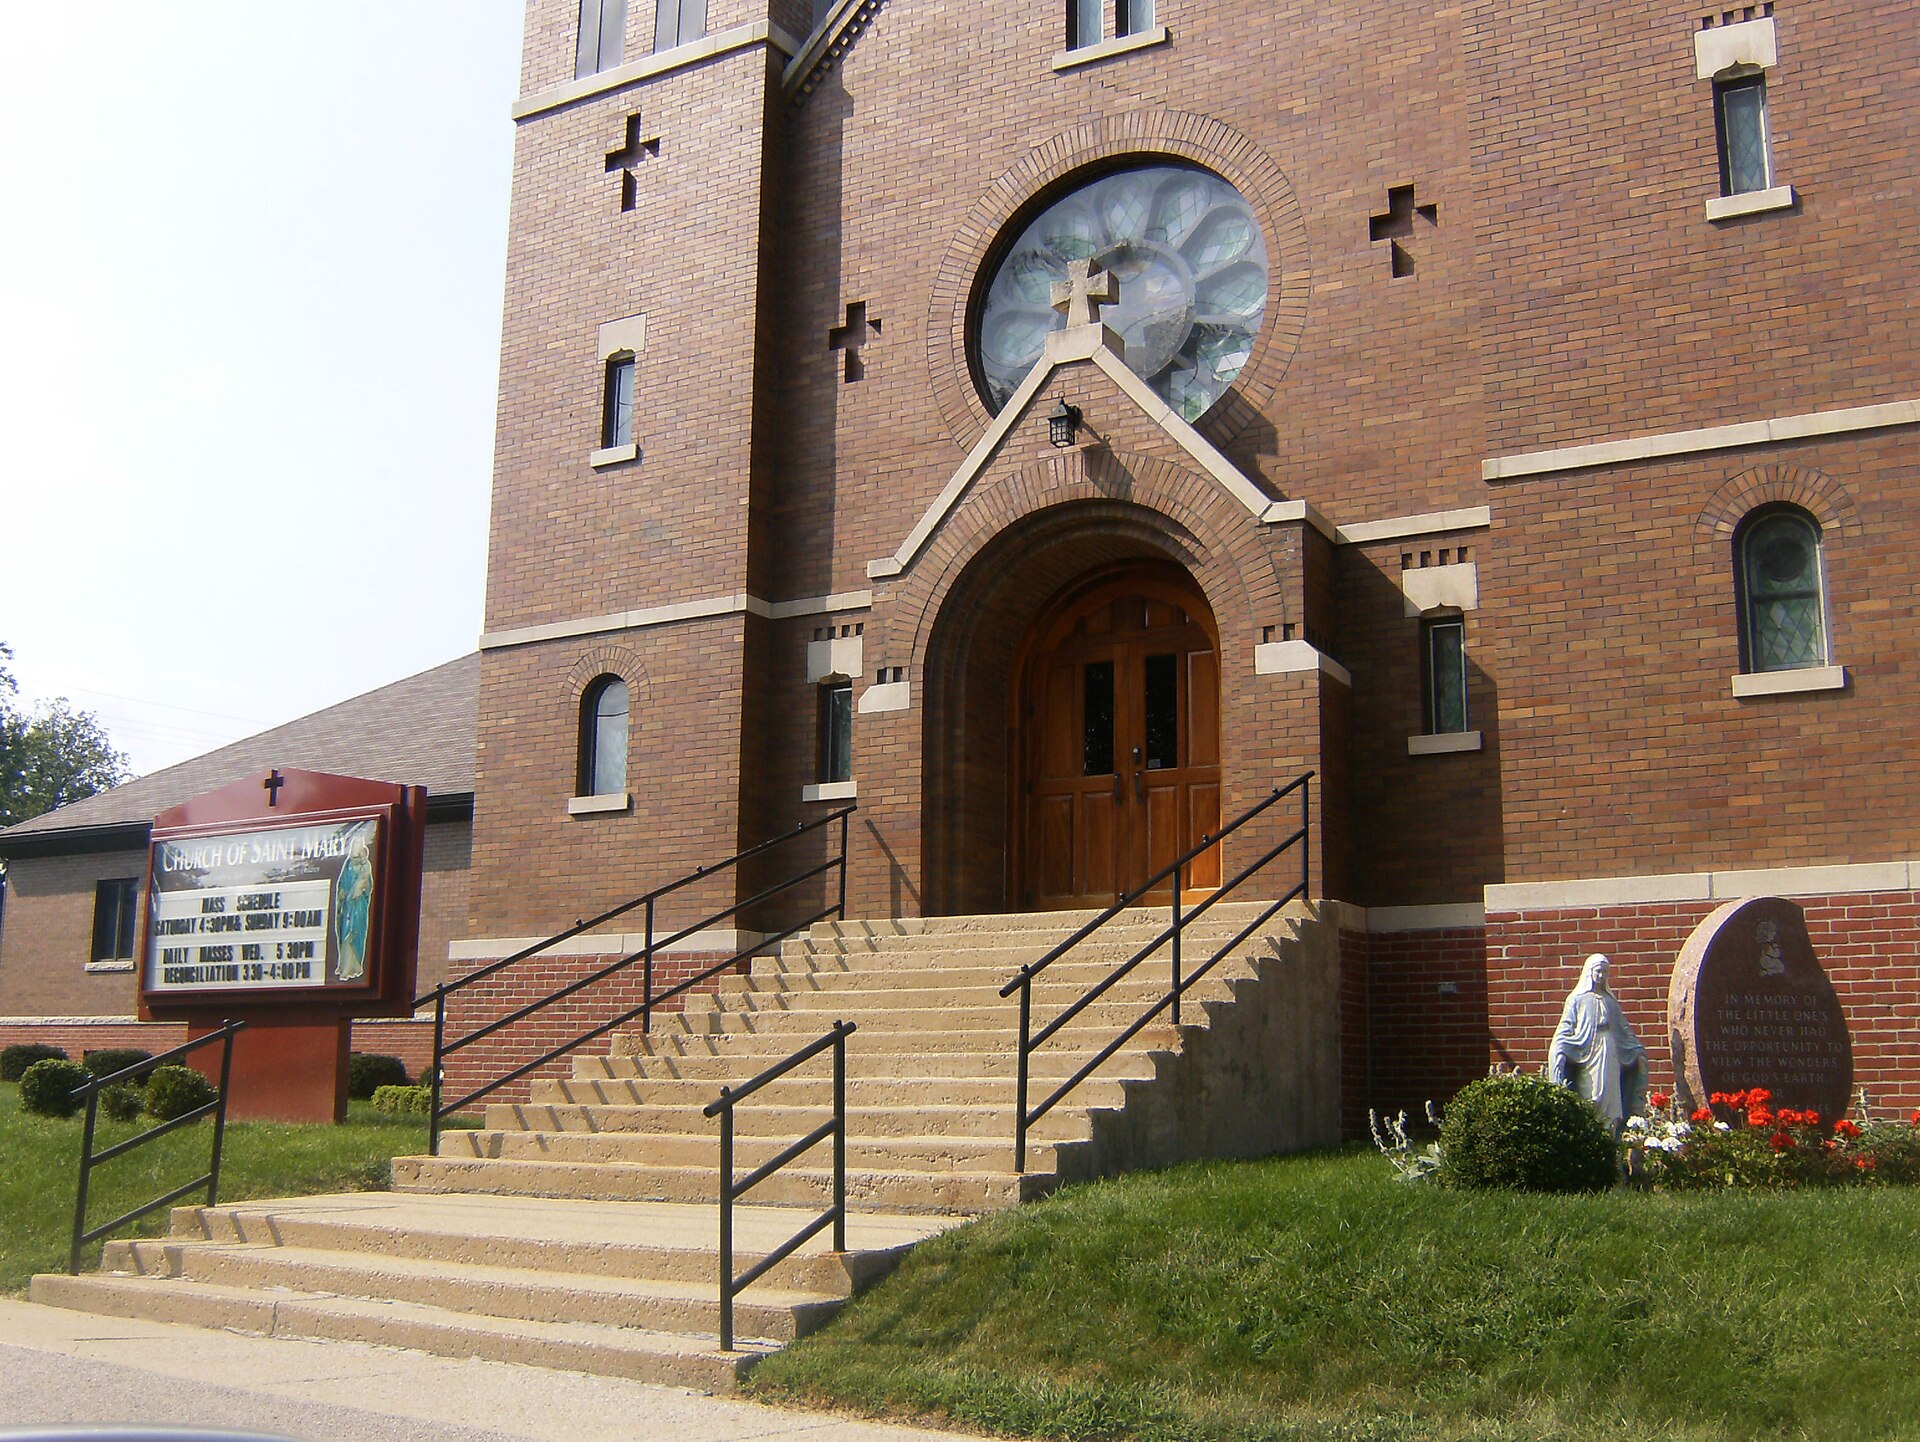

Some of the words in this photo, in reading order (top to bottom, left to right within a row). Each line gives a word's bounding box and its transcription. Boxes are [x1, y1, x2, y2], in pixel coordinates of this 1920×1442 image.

[163, 846, 221, 872] CHURCH
[227, 842, 248, 866] OF
[251, 835, 298, 863] SAINT
[302, 832, 349, 858] MARY
[202, 896, 226, 913] MASS
[237, 892, 280, 911] SCHEDULE
[155, 917, 196, 936] SATURDAY
[245, 912, 280, 930] SUNDAY
[283, 909, 322, 928] 9:00AM
[163, 947, 188, 964] DAILY
[200, 945, 233, 962] MASSES
[242, 943, 264, 960] WED.
[164, 965, 238, 983] RECONCILIATION
[1725, 994, 1738, 1004] IN
[1745, 994, 1797, 1005] MEMORY
[1804, 995, 1818, 1006] OF
[1717, 1009, 1741, 1020] THE
[1746, 1010, 1788, 1020] LITTLE
[1794, 1010, 1829, 1021] ONE'S
[1721, 1025, 1749, 1036] WHO
[1754, 1025, 1793, 1036] NEVER
[1800, 1026, 1826, 1037] HAD
[1704, 1040, 1728, 1051] THE
[1734, 1041, 1820, 1052] OPPORTUNITY
[1827, 1041, 1842, 1052] TO
[1712, 1056, 1742, 1067] VIEW
[1749, 1056, 1772, 1067] THE
[1778, 1057, 1838, 1068] WONDERS
[1722, 1072, 1736, 1082] OF
[1742, 1072, 1779, 1083] GOD'S
